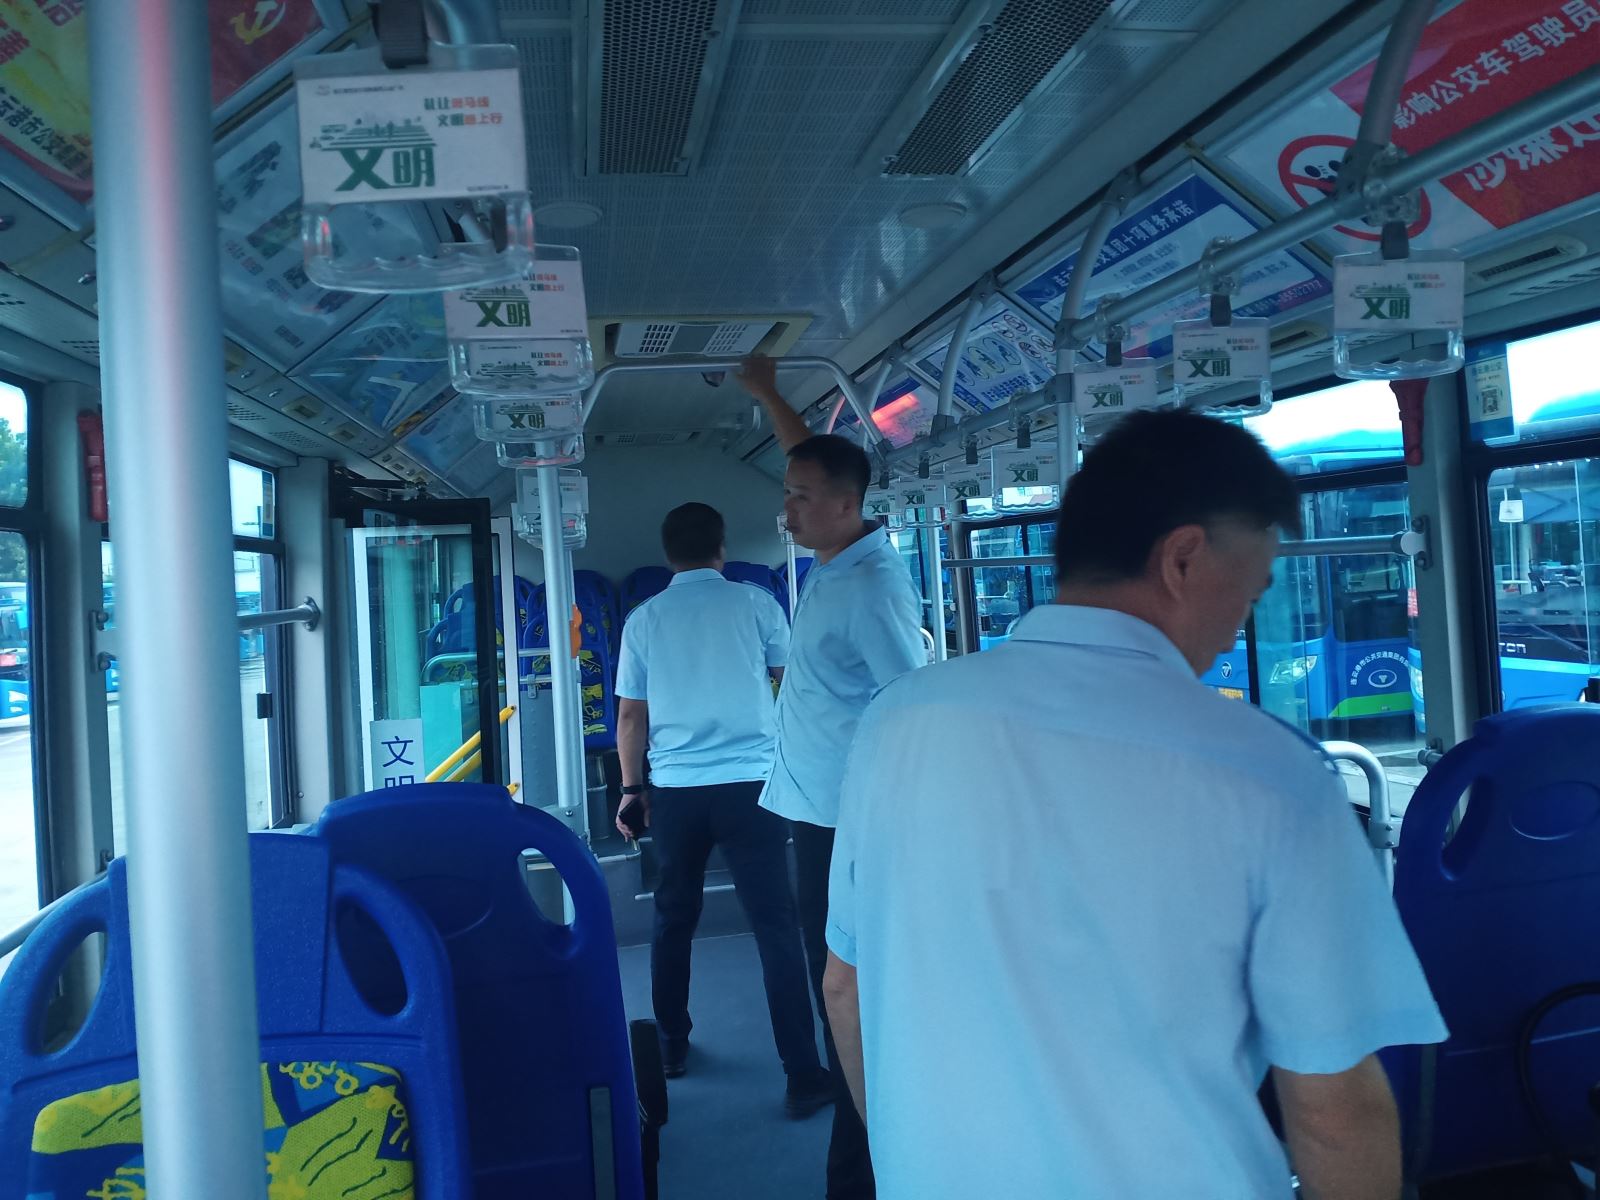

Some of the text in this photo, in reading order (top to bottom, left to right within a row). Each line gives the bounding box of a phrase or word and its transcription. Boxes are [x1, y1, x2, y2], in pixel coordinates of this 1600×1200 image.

[1393, 0, 1600, 129] 影响公交车驾驶员
[335, 147, 436, 191] 文明
[476, 299, 531, 327] 文明
[1360, 297, 1411, 320] 文明
[1187, 358, 1231, 378] 文明
[1091, 391, 1124, 409] 文明
[509, 413, 546, 429] 文明
[1012, 468, 1039, 482] 文明
